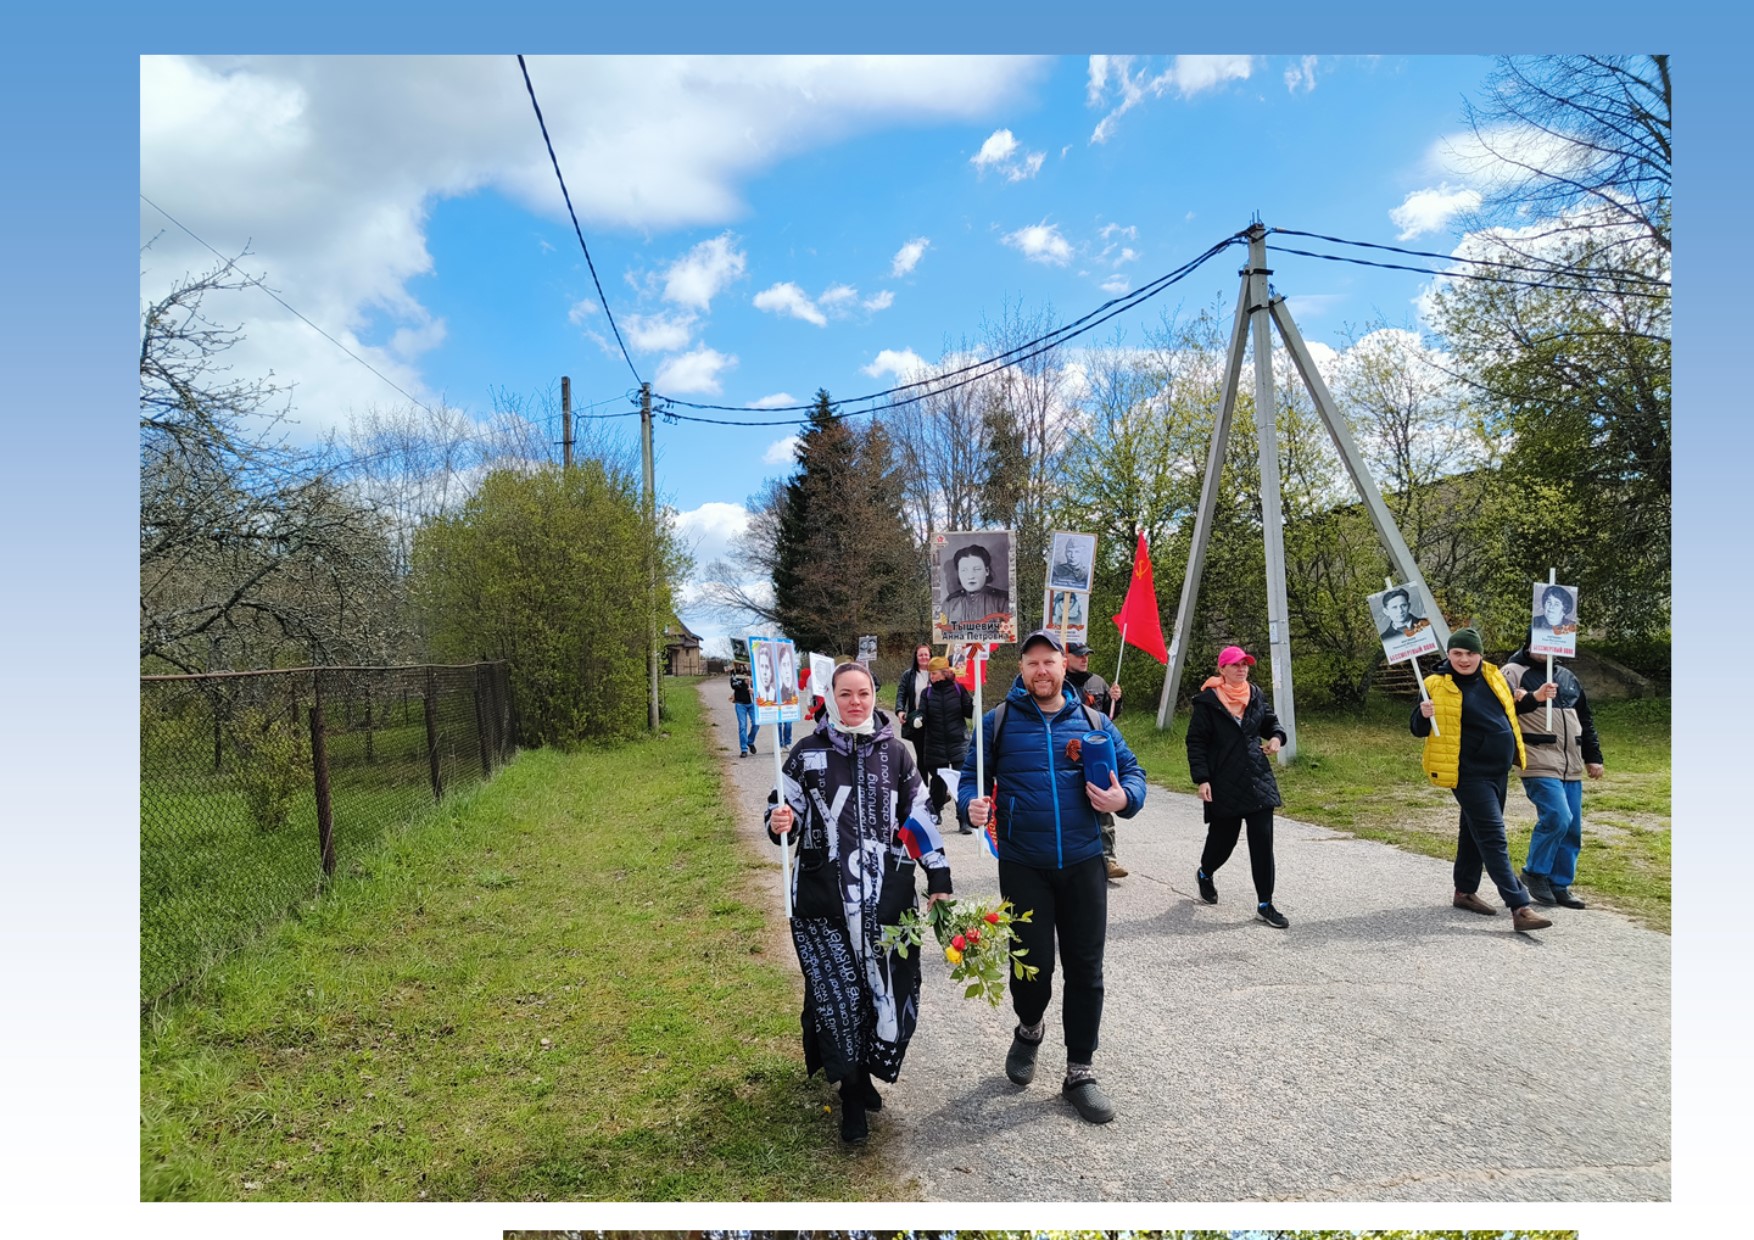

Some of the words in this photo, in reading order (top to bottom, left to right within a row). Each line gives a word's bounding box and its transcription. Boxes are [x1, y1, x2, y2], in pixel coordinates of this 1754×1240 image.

[942, 632, 965, 641] Анна
[966, 631, 1010, 642] Петровна
[951, 620, 1000, 631] Тышевич
[881, 764, 891, 784] you
[867, 773, 879, 825] amusing
[880, 786, 890, 821] about
[826, 926, 859, 982] answer
[838, 1002, 850, 1026] care
